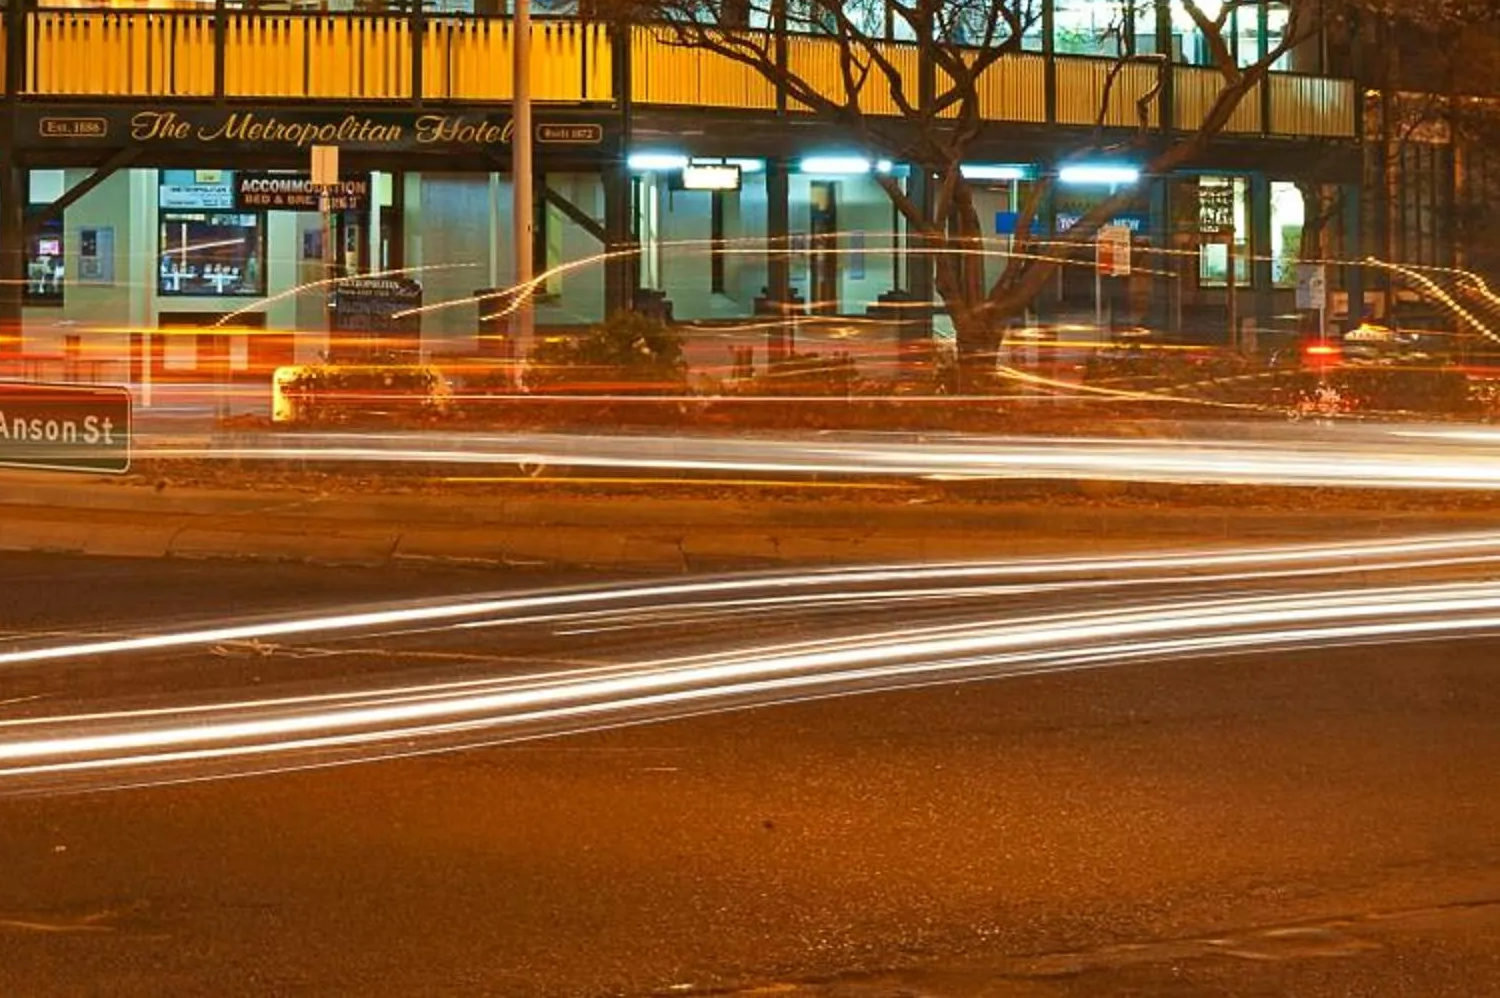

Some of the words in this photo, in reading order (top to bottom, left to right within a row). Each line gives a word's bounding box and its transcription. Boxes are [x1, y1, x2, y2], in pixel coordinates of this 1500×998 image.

[131, 111, 190, 141] The
[197, 113, 402, 146] Metropolitan
[415, 115, 513, 144] Hotel
[83, 415, 114, 445] St
